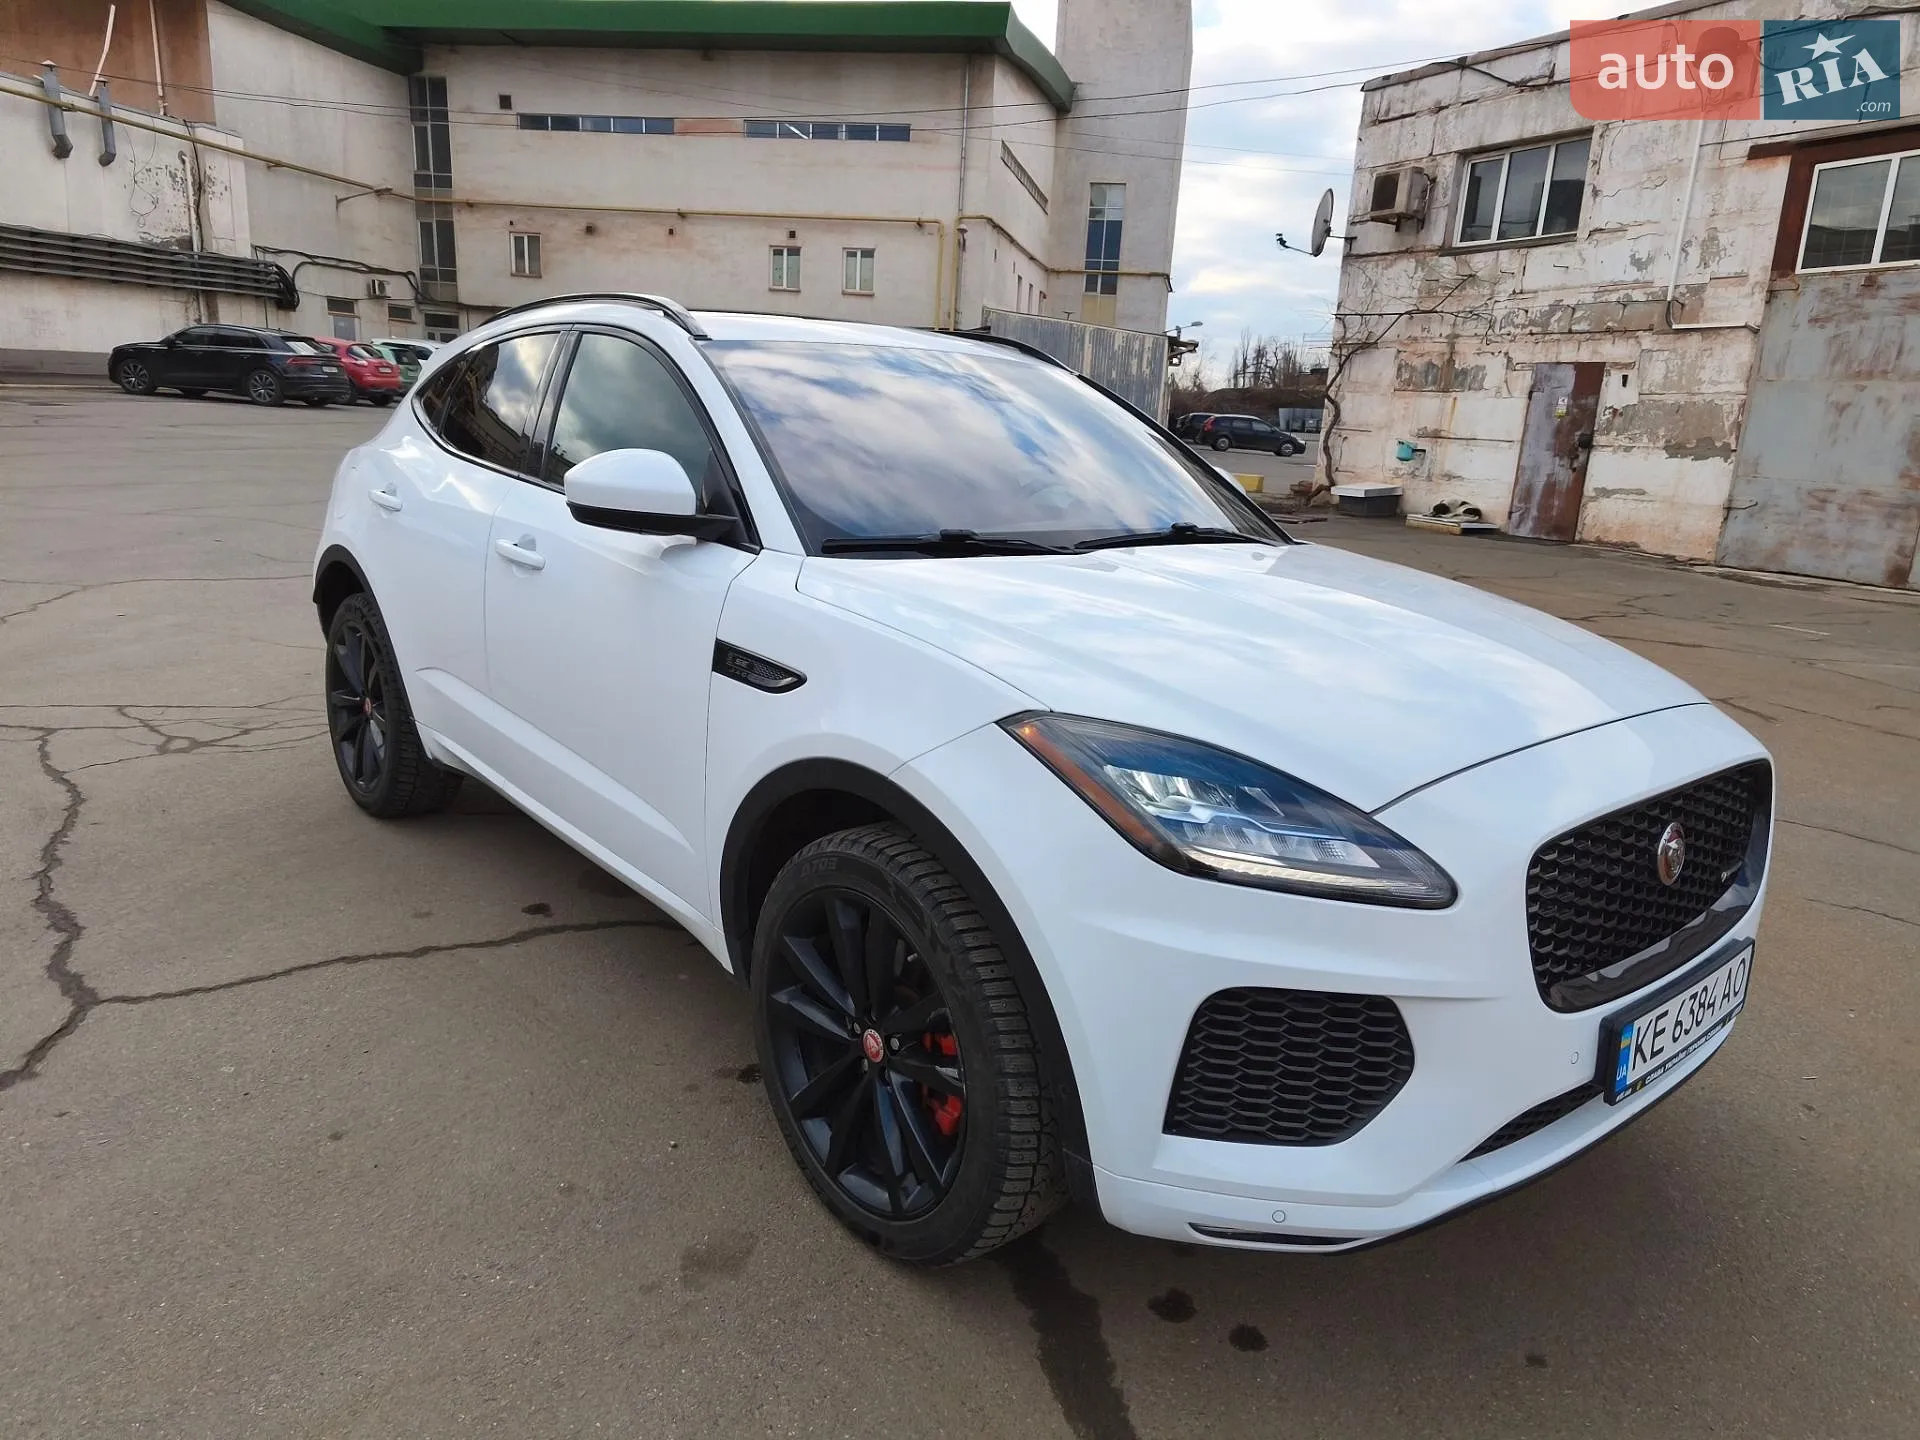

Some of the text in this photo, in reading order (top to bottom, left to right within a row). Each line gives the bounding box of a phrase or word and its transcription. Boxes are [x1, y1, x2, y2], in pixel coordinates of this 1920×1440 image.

[1632, 957, 1746, 1071] KE 6384 AO
[1616, 1063, 1627, 1081] UA
